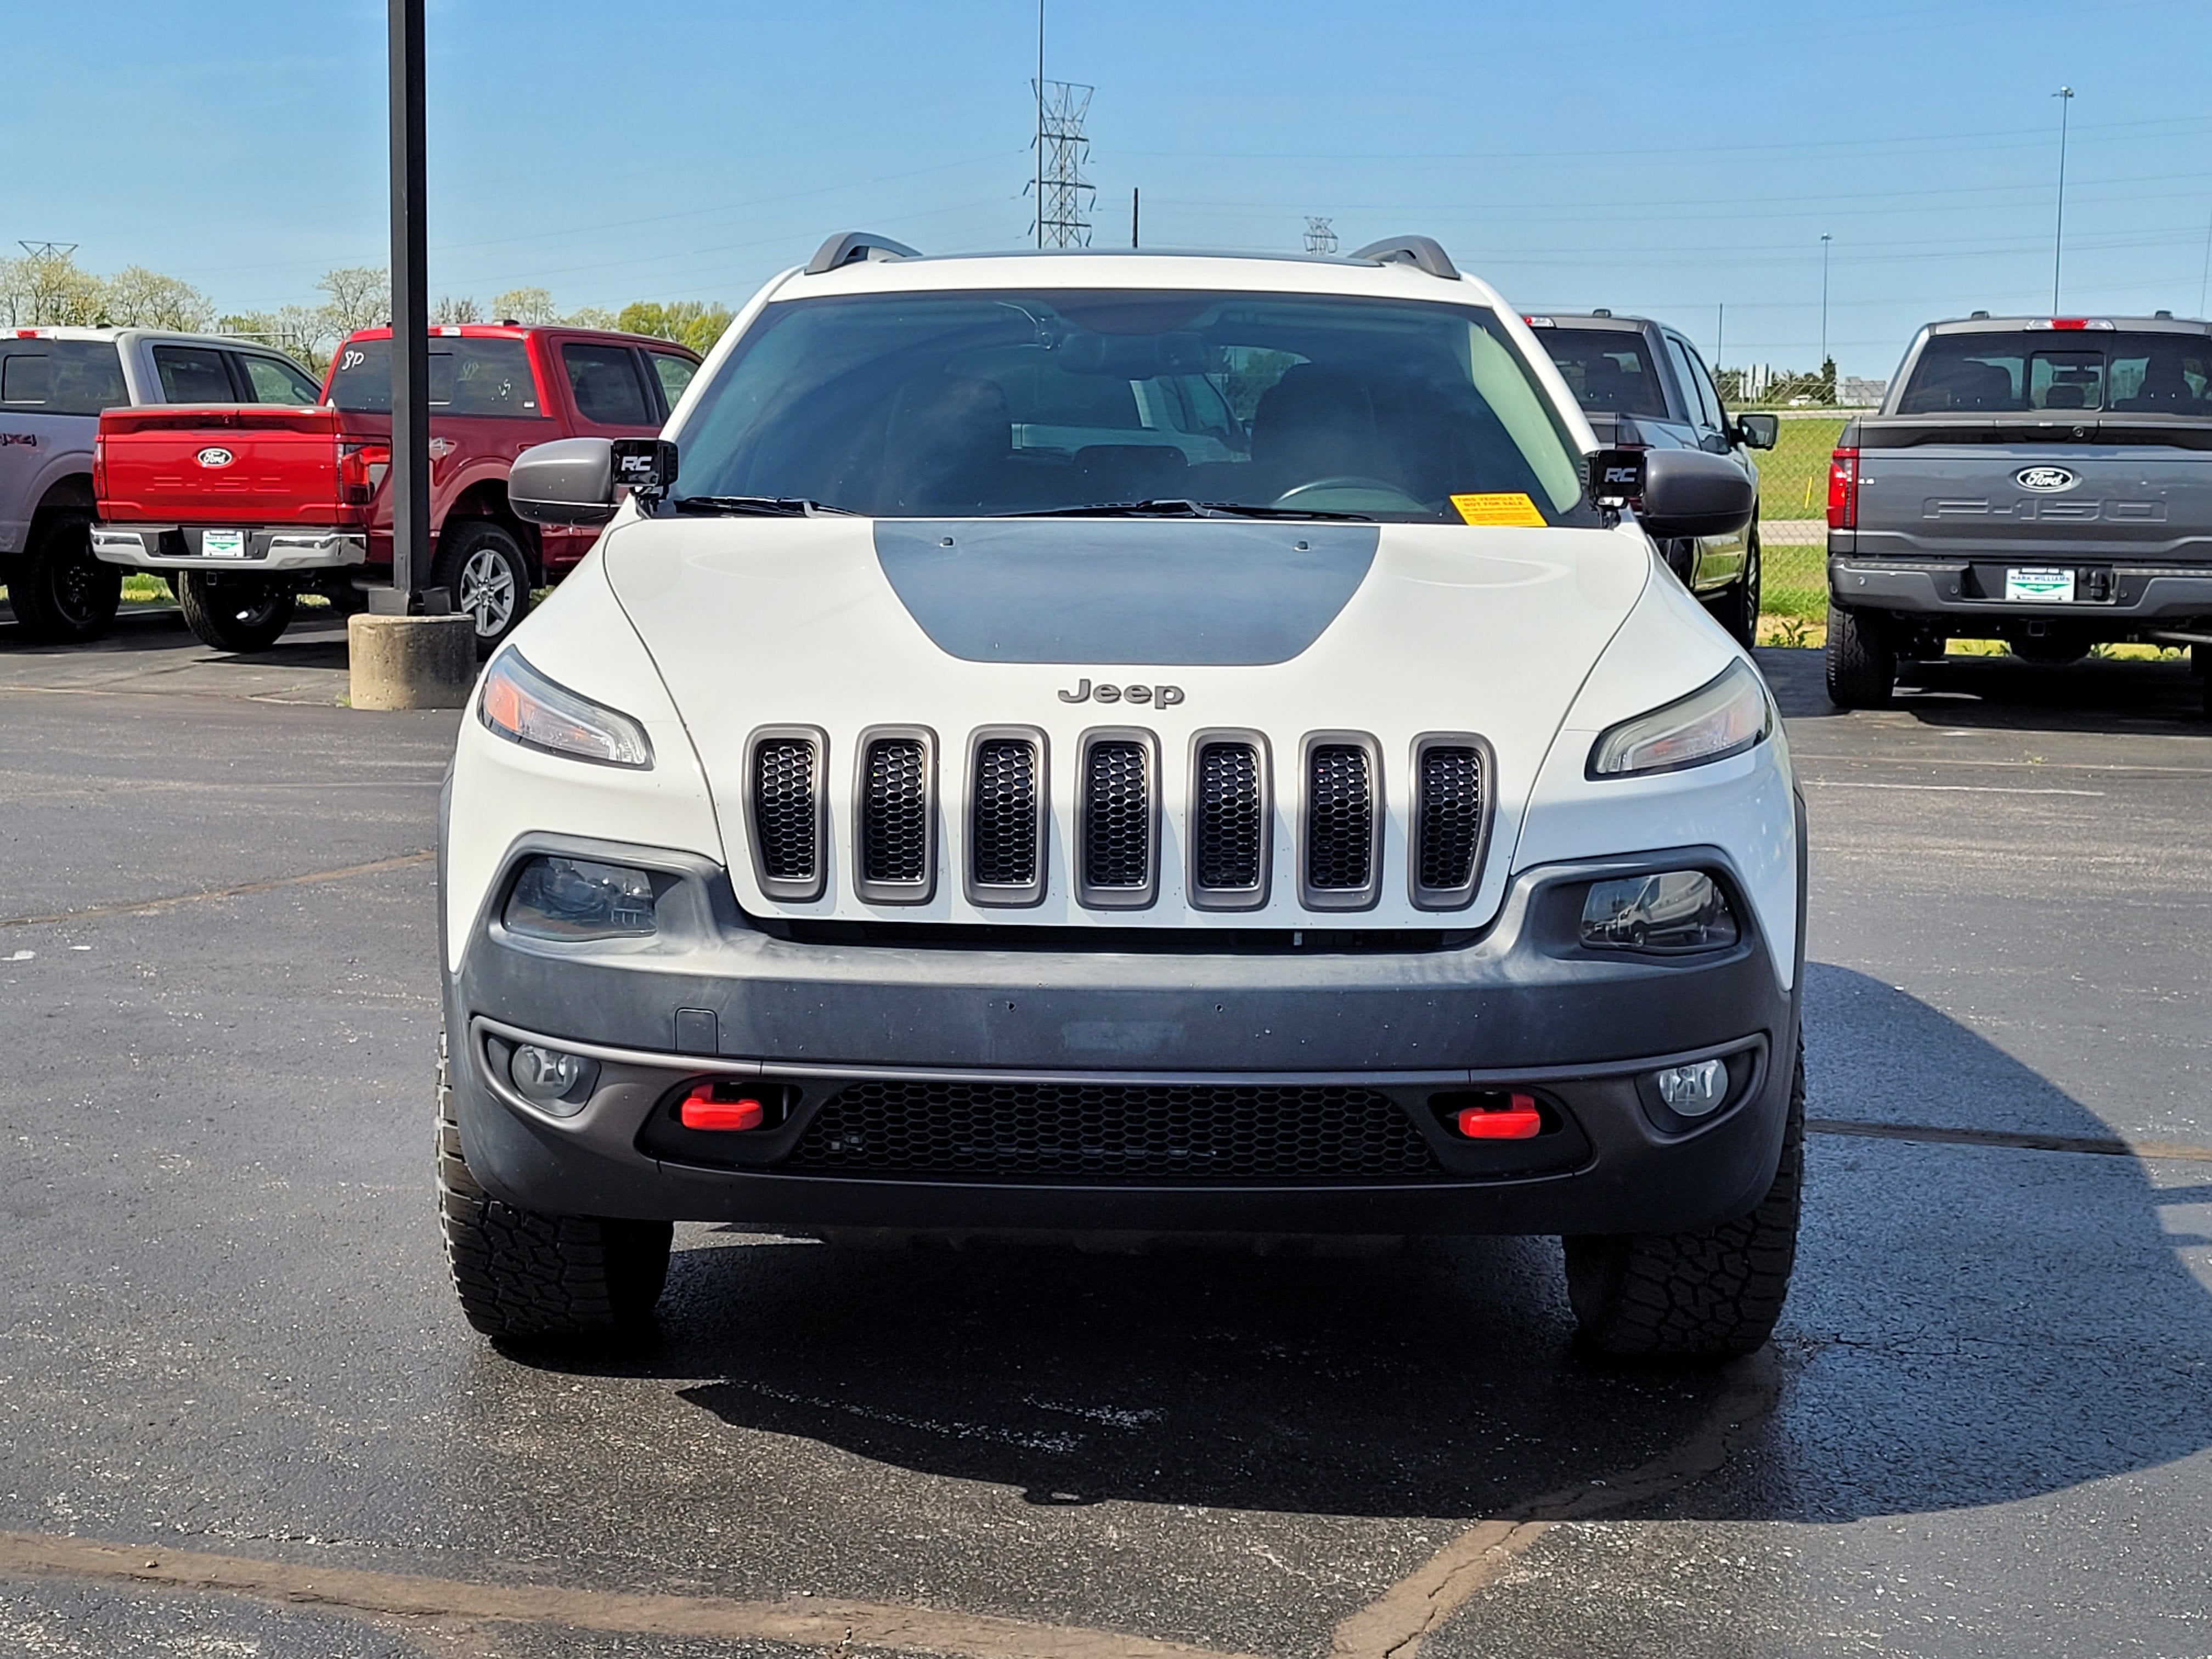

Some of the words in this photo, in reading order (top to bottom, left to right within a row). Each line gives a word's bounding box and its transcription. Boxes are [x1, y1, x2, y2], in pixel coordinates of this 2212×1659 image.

[203, 450, 226, 464] Ford
[621, 456, 652, 471] RC
[1604, 467, 1637, 482] RC
[2026, 471, 2063, 487] Ford
[1922, 497, 2167, 522] F-150
[1058, 679, 1185, 709] Jeep
